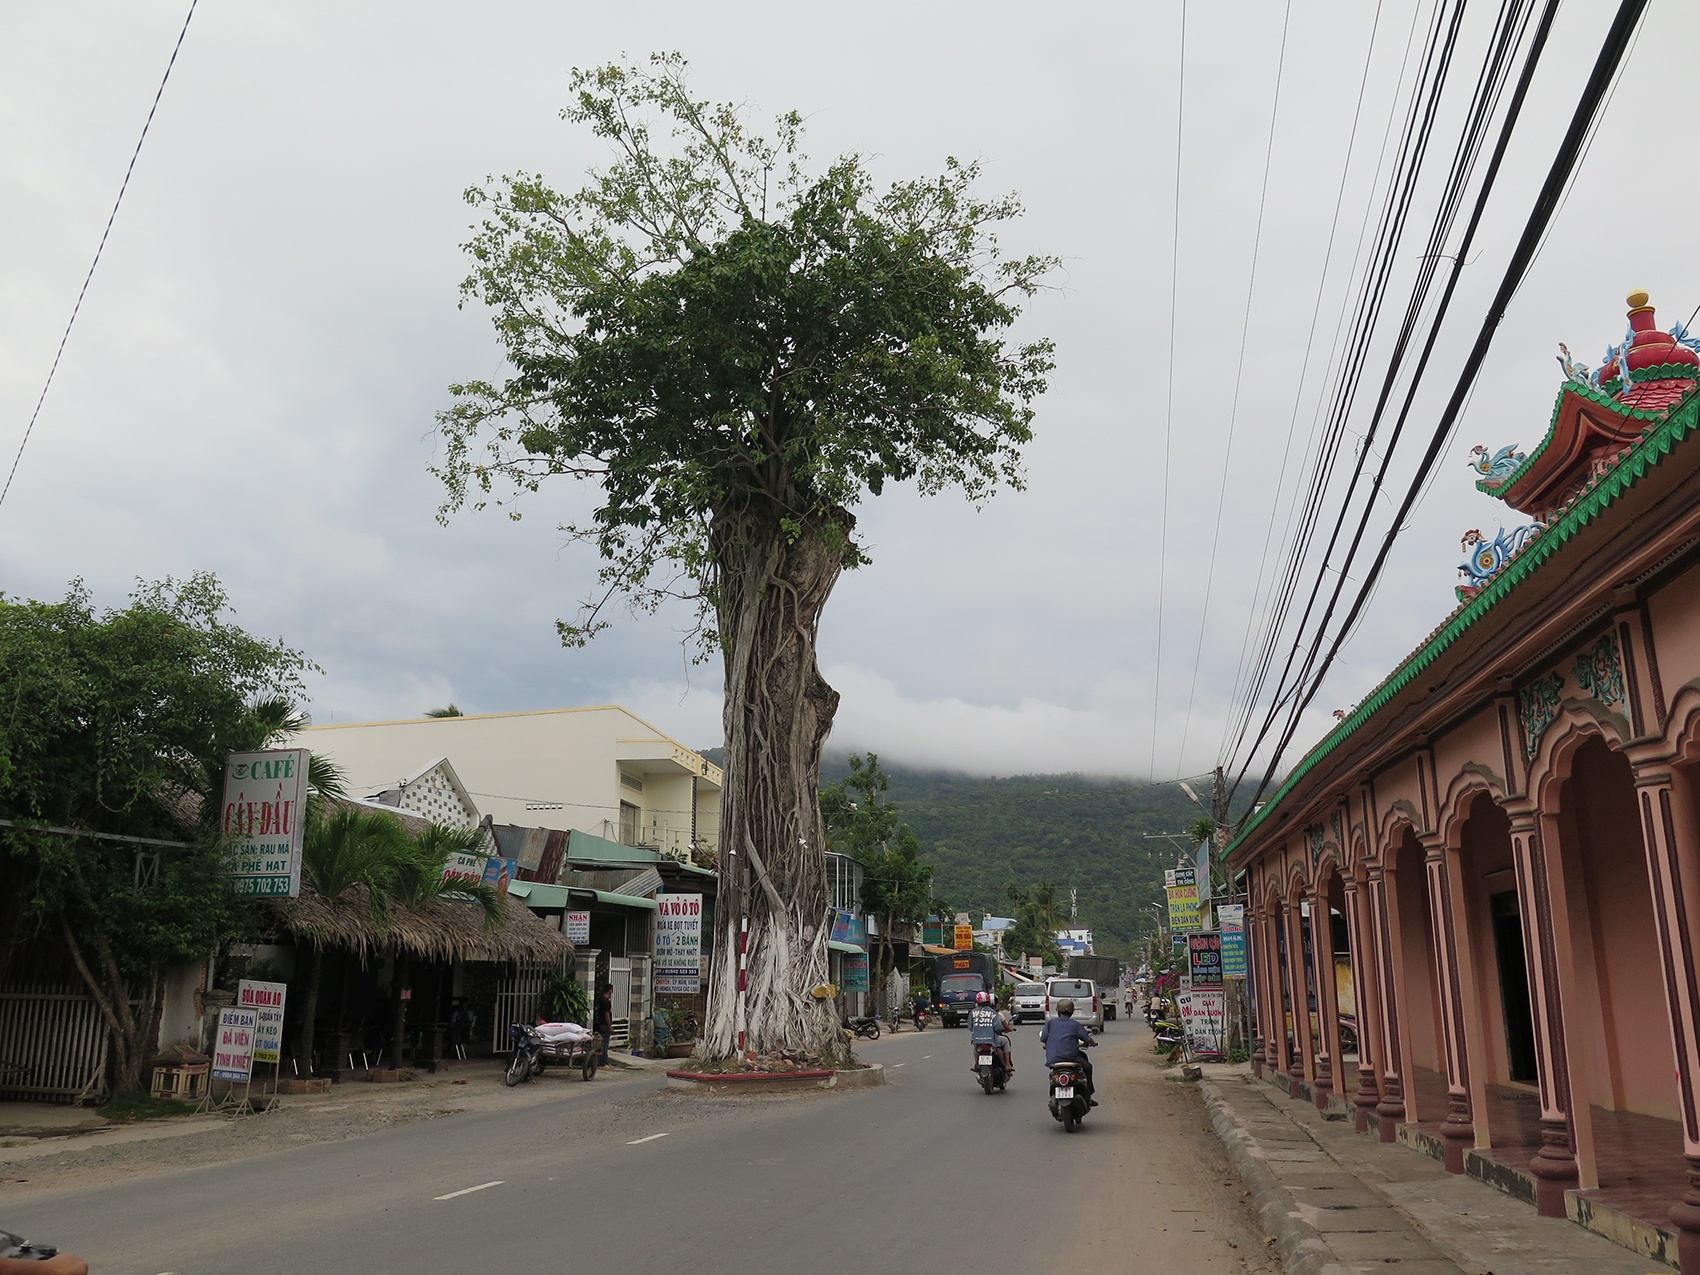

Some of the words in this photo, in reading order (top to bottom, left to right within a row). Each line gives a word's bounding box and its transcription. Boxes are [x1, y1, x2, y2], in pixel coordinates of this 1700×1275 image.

[251, 754, 294, 780] CAFÉ
[260, 843, 276, 855] RAU
[278, 841, 290, 855] MÁ
[241, 859, 262, 872] PHÊ
[266, 860, 287, 874] HẠT
[256, 878, 272, 893] 702
[274, 878, 289, 893] 753
[658, 898, 670, 916] VÁ
[671, 896, 681, 916] VỎ
[682, 899, 688, 916] Ô
[689, 899, 700, 916] TÔ
[676, 936, 681, 945] 2
[681, 934, 699, 946] BÁNH
[1193, 952, 1219, 966] LED
[240, 1012, 254, 1027] BÁN
[234, 1029, 250, 1047] VIÊN
